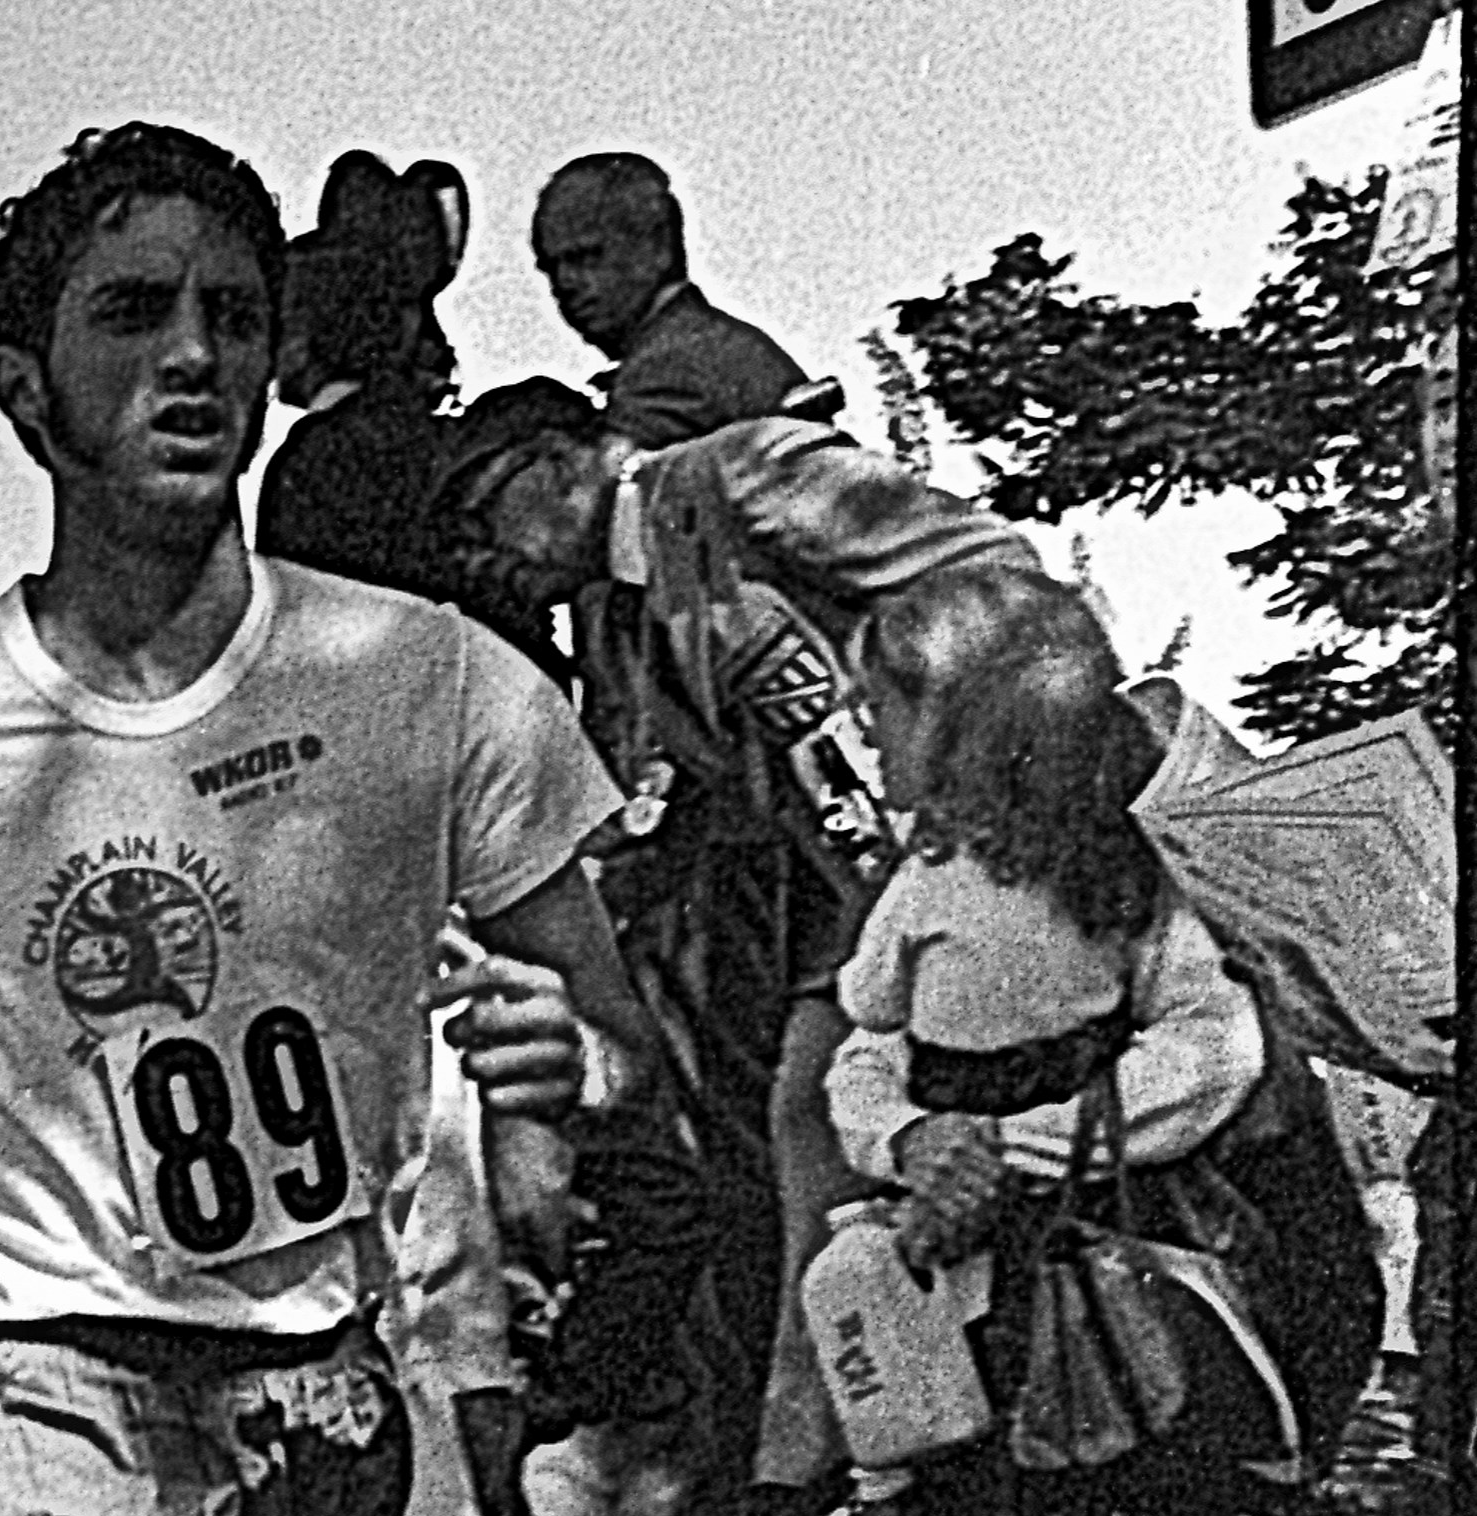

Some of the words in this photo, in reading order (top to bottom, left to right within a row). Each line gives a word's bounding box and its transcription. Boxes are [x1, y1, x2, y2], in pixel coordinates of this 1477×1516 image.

[23, 836, 157, 966] CHAMPLAIN
[176, 842, 244, 934] VALLEY
[133, 1005, 349, 1254] 89
